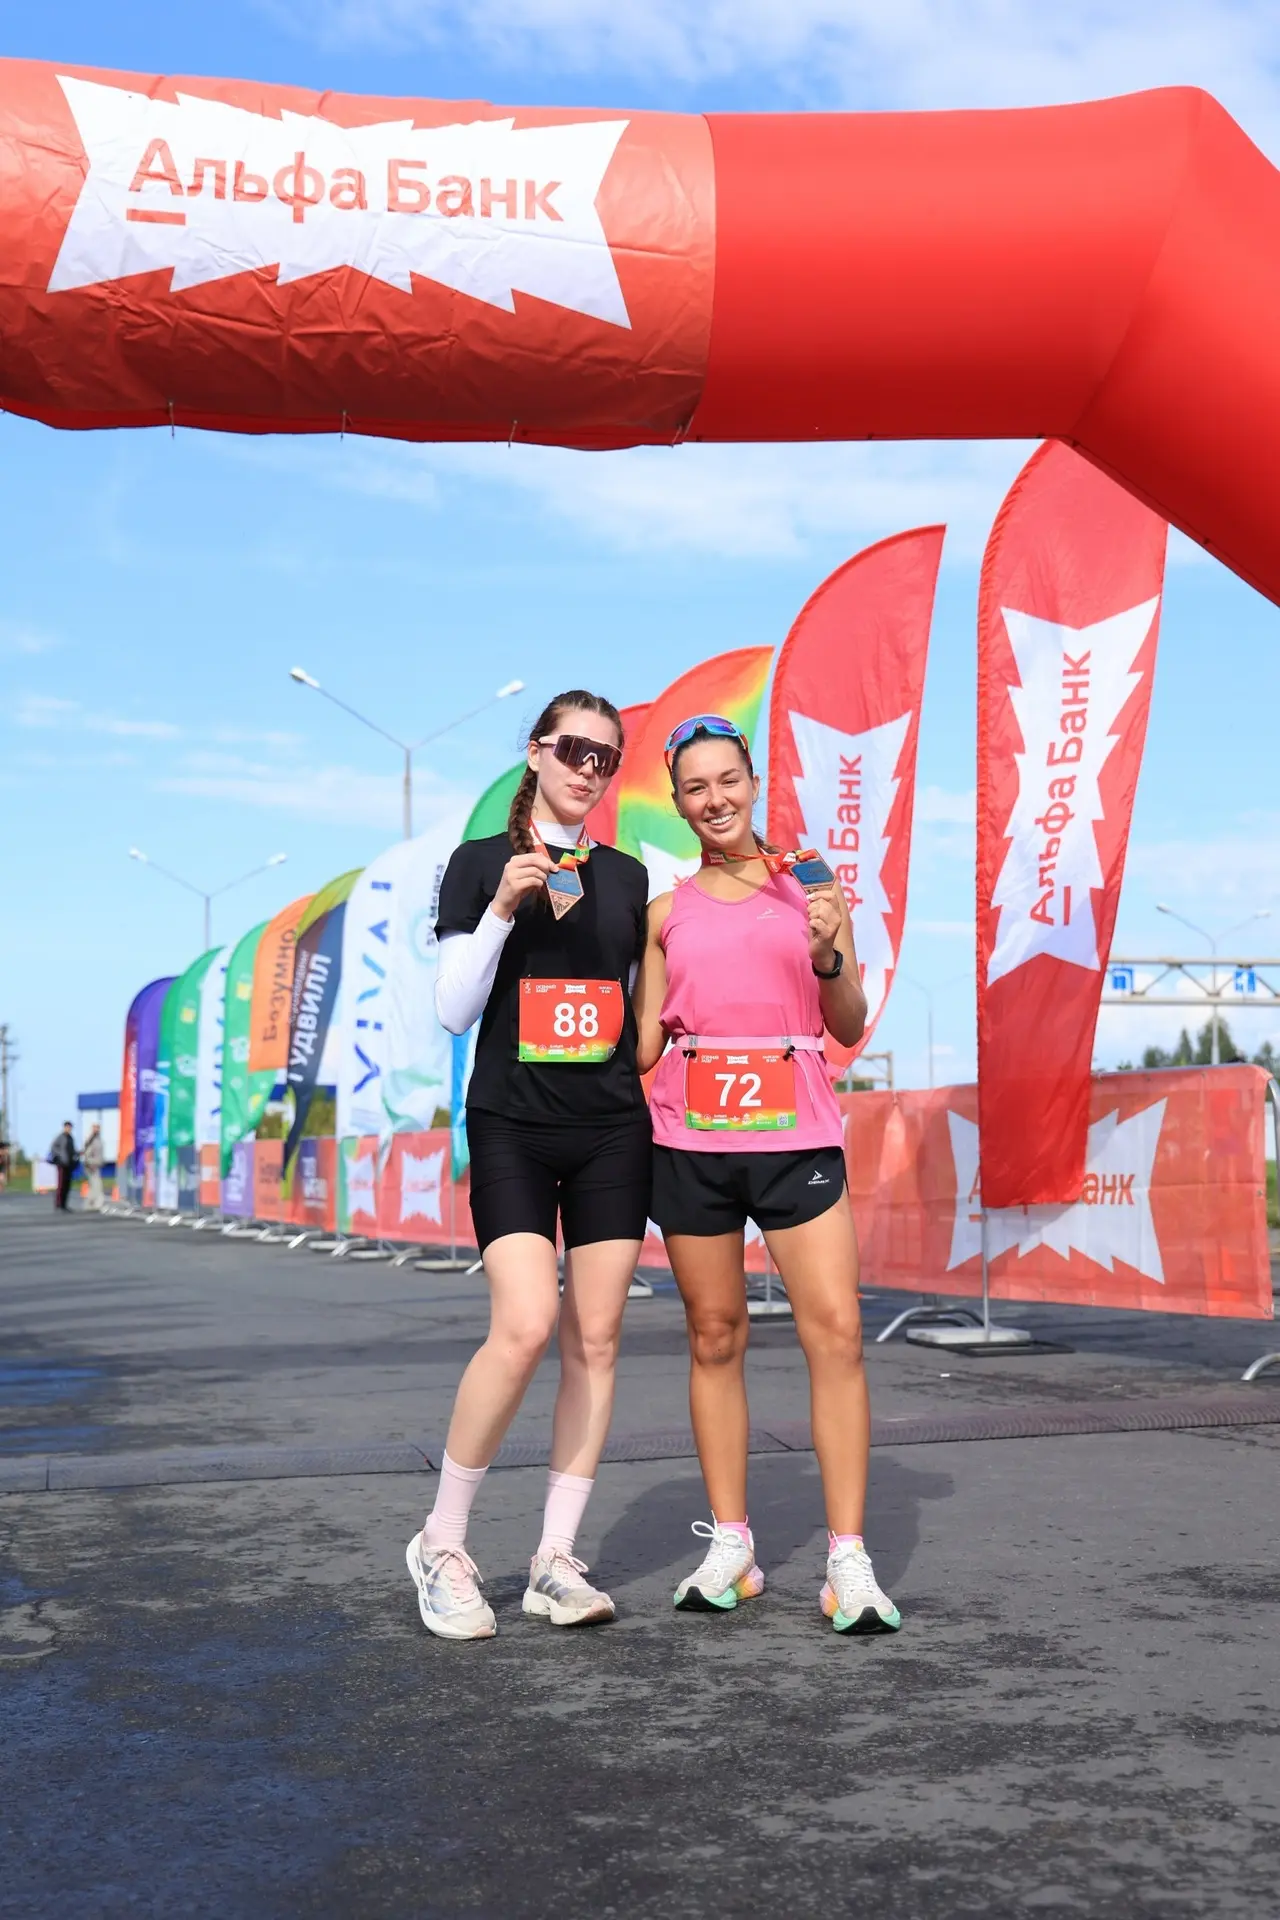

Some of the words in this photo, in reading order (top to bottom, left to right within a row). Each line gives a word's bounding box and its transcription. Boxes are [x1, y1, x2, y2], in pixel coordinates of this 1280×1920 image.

[126, 137, 367, 224] Альфа
[386, 157, 564, 222] Банк
[1047, 650, 1092, 768] Банк
[828, 753, 863, 853] Банк
[1029, 774, 1078, 927] Альфа
[553, 1002, 599, 1038] 88
[715, 1072, 762, 1107] 72
[1082, 1172, 1136, 1206] анк
